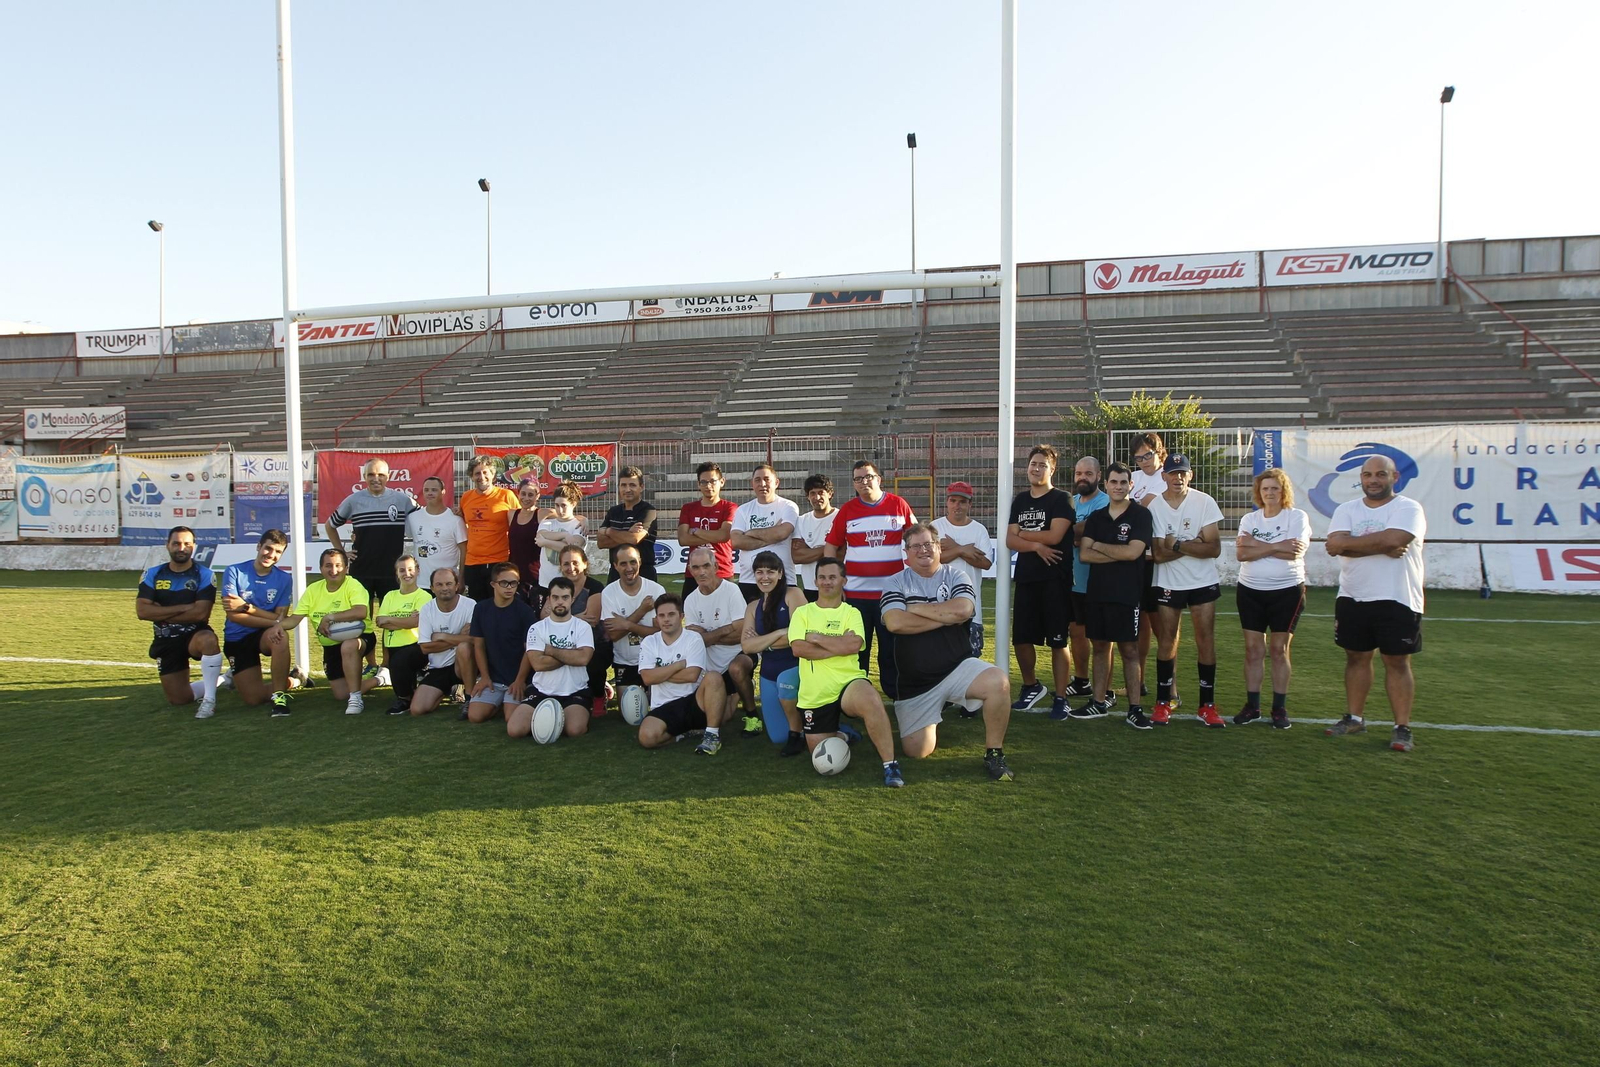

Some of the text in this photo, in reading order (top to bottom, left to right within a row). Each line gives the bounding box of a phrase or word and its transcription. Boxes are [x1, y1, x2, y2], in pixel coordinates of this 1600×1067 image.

[1283, 252, 1434, 273] KSR MOTO
[1128, 259, 1246, 286] Malaguti
[1377, 268, 1427, 276] AUSTRIA
[85, 334, 146, 350] TRIUMPH
[555, 461, 602, 473] BOUQUET
[1452, 502, 1600, 526] CLAN
[155, 580, 172, 590] 26
